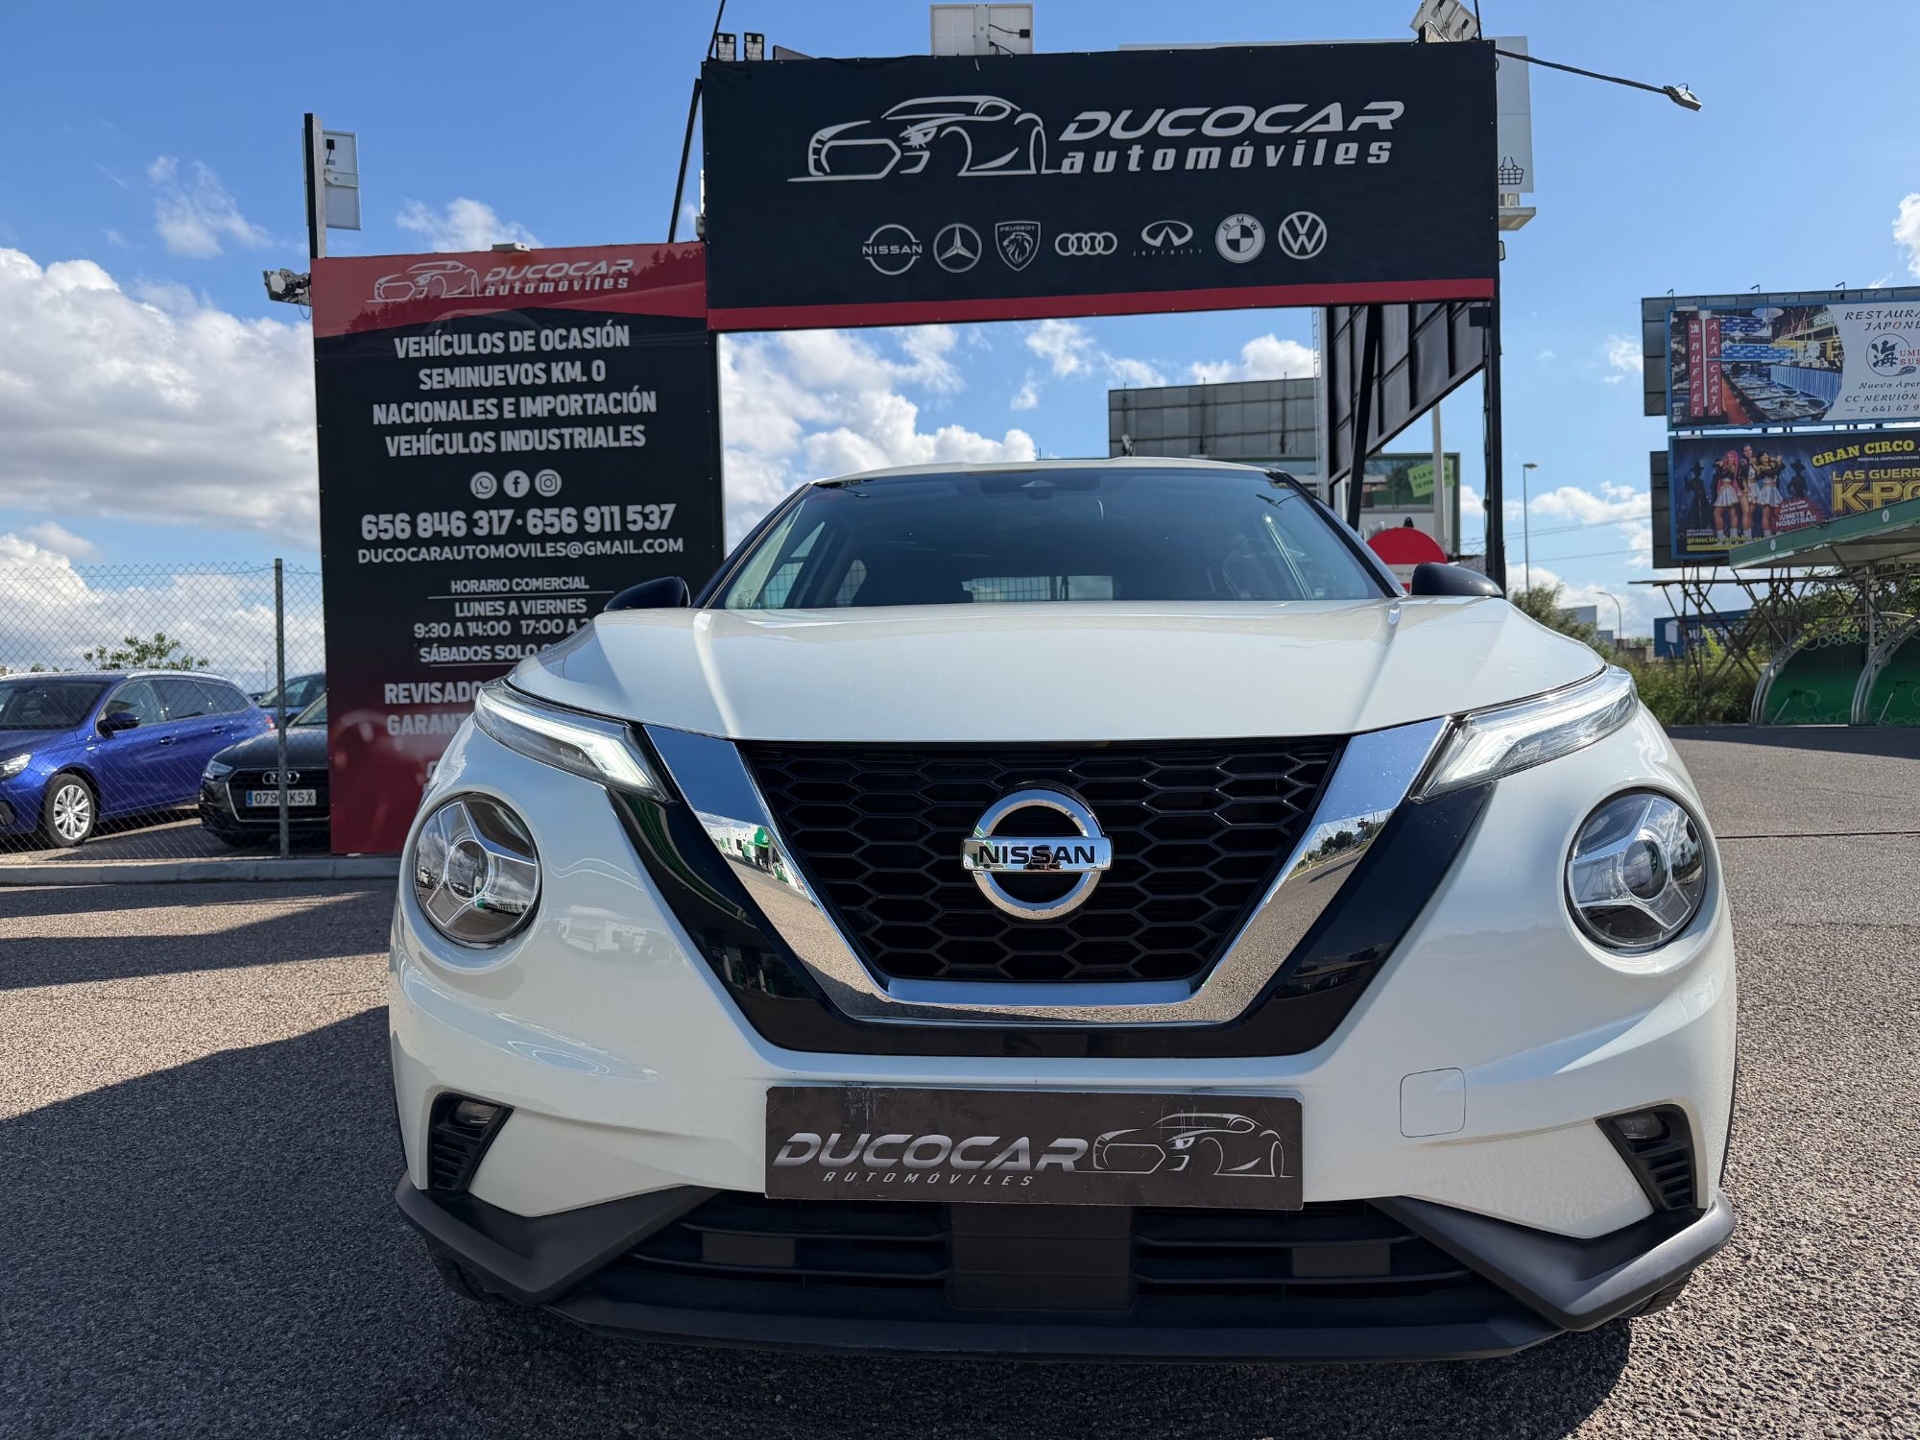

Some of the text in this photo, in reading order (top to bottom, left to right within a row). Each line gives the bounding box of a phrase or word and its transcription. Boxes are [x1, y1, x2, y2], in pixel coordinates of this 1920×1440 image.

[1058, 101, 1405, 141] DUCOCAR
[1061, 139, 1392, 174] automóviles
[862, 244, 922, 255] NISSAN
[484, 259, 634, 282] DUCOCAR
[485, 276, 629, 297] automóviles
[1845, 310, 1920, 320] RESTAUR
[394, 319, 630, 358] VEHÍCULOS DE OCASIÓN
[419, 362, 547, 390] SEMINUEVOS
[551, 361, 588, 384] KM.
[1691, 342, 1701, 415] BUFFET
[1859, 381, 1892, 390] Nueva
[1710, 365, 1720, 414] CARTA
[1845, 395, 1860, 403] CC
[373, 385, 657, 425] NACIONALES E IMPORTACIÓN
[385, 424, 646, 457] VEHÍCULOS INDUSTRIALES
[1812, 440, 1915, 467] GRAN CIRCO
[1832, 470, 1865, 481] LAS
[361, 513, 411, 541] 656
[416, 510, 467, 538] 846
[583, 505, 621, 533] 911
[626, 503, 677, 531] 537
[358, 538, 684, 564] DUCOCARAUTOMOVILES@GMAIL.COM
[451, 576, 590, 594] HORARIO COMERCIAL
[455, 598, 587, 617] LUNES A VIERNES
[413, 622, 450, 639] 9:30
[453, 622, 465, 637] A
[466, 620, 511, 637] 14:00
[521, 618, 564, 635] 17:00
[566, 617, 577, 633] A
[420, 643, 491, 663] SÁBADOS
[289, 791, 313, 804] KSX
[979, 845, 1095, 864] NISSAN
[773, 1132, 1089, 1171] DUCOCAR
[823, 1171, 1034, 1186] AUTOMÓVILES
